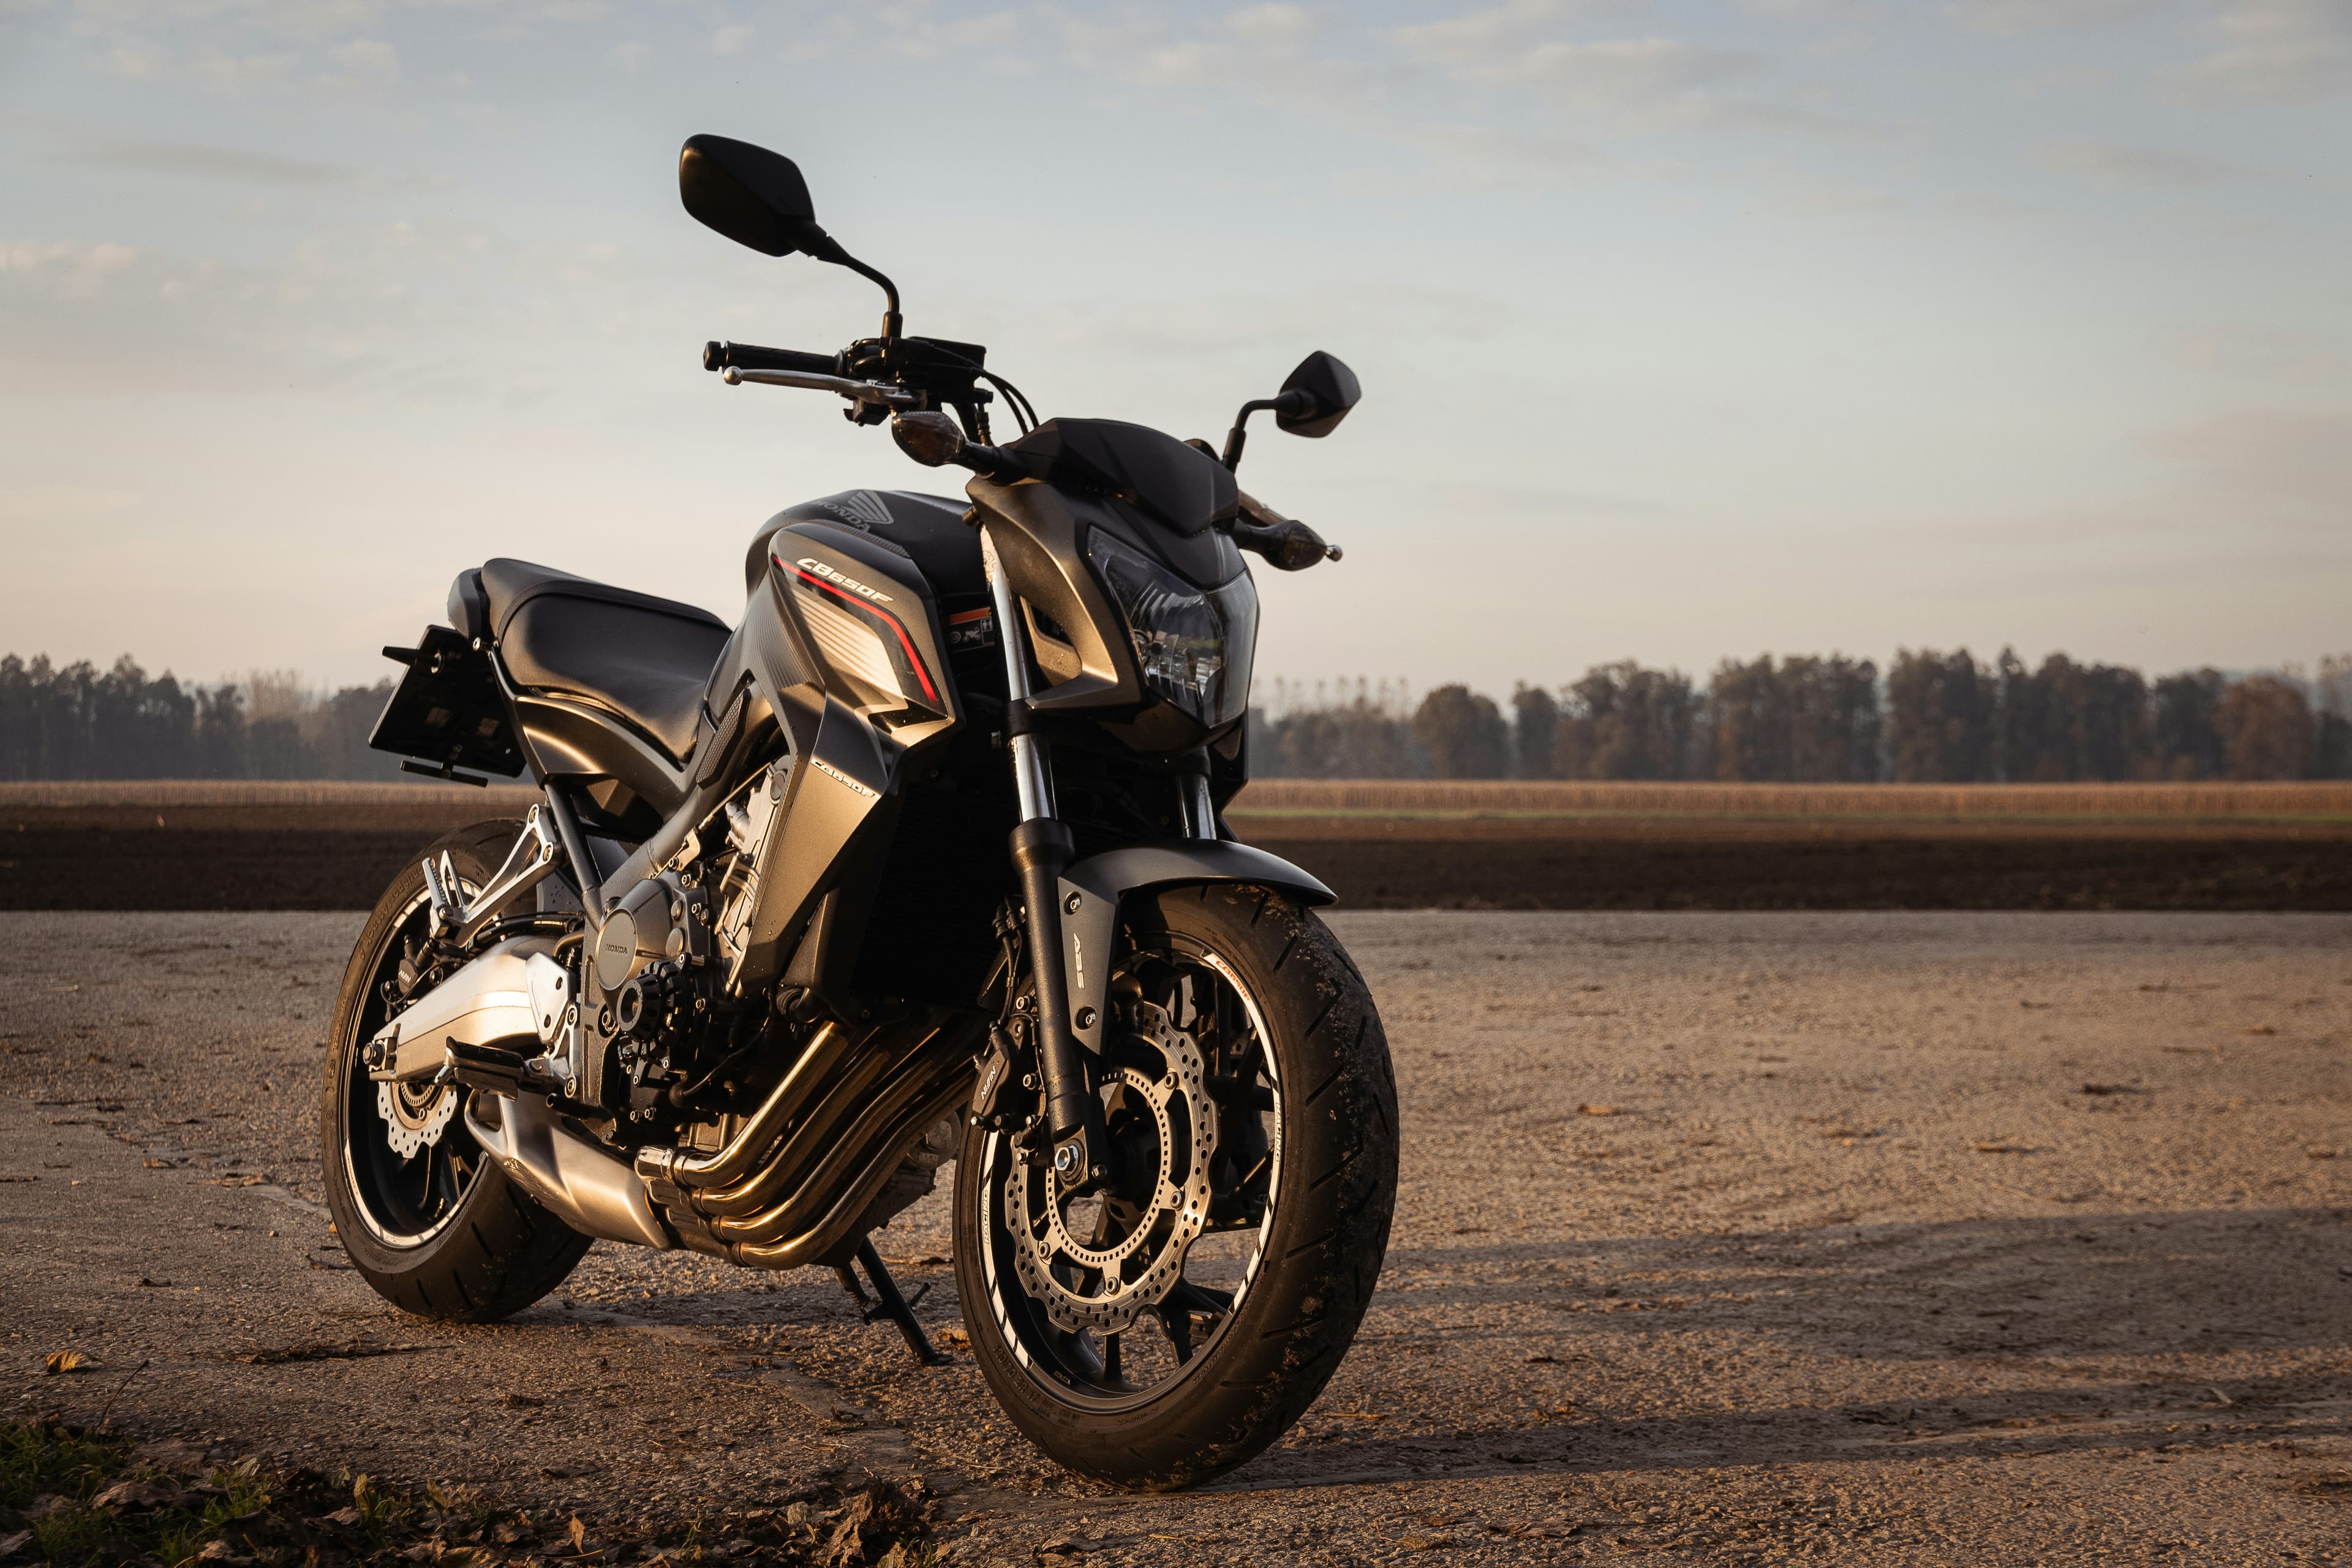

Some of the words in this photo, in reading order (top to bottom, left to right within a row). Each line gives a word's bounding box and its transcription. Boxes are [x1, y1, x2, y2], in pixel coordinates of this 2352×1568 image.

[797, 558, 894, 603] CB650F
[606, 944, 628, 954] HONDA
[1074, 932, 1085, 989] ABS
[993, 1344, 1017, 1378] 120/70
